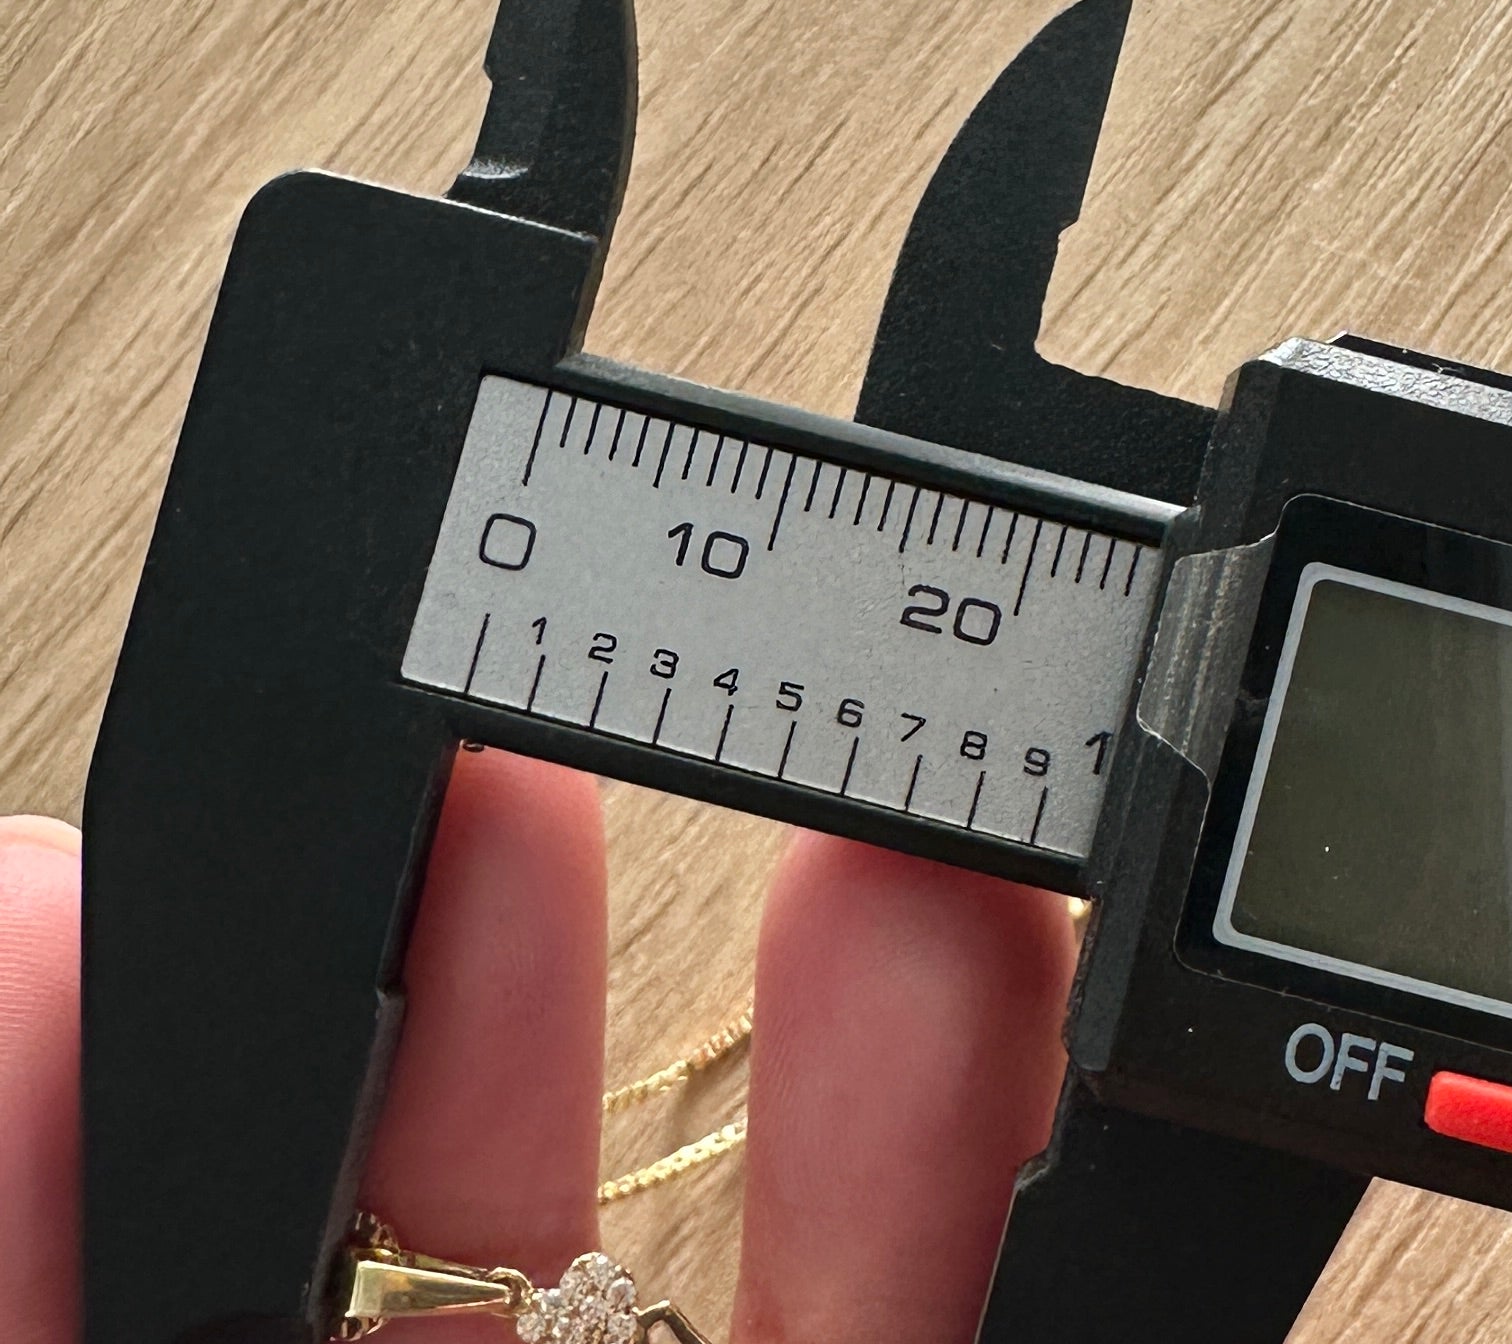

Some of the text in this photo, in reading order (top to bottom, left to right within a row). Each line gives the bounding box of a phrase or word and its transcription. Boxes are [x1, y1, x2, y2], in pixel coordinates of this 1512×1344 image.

[480, 512, 1001, 646] 0 10 20
[530, 616, 1113, 776] 1 2 3 4 5 6 7 8 9 1
[1284, 1021, 1415, 1102] OFF
